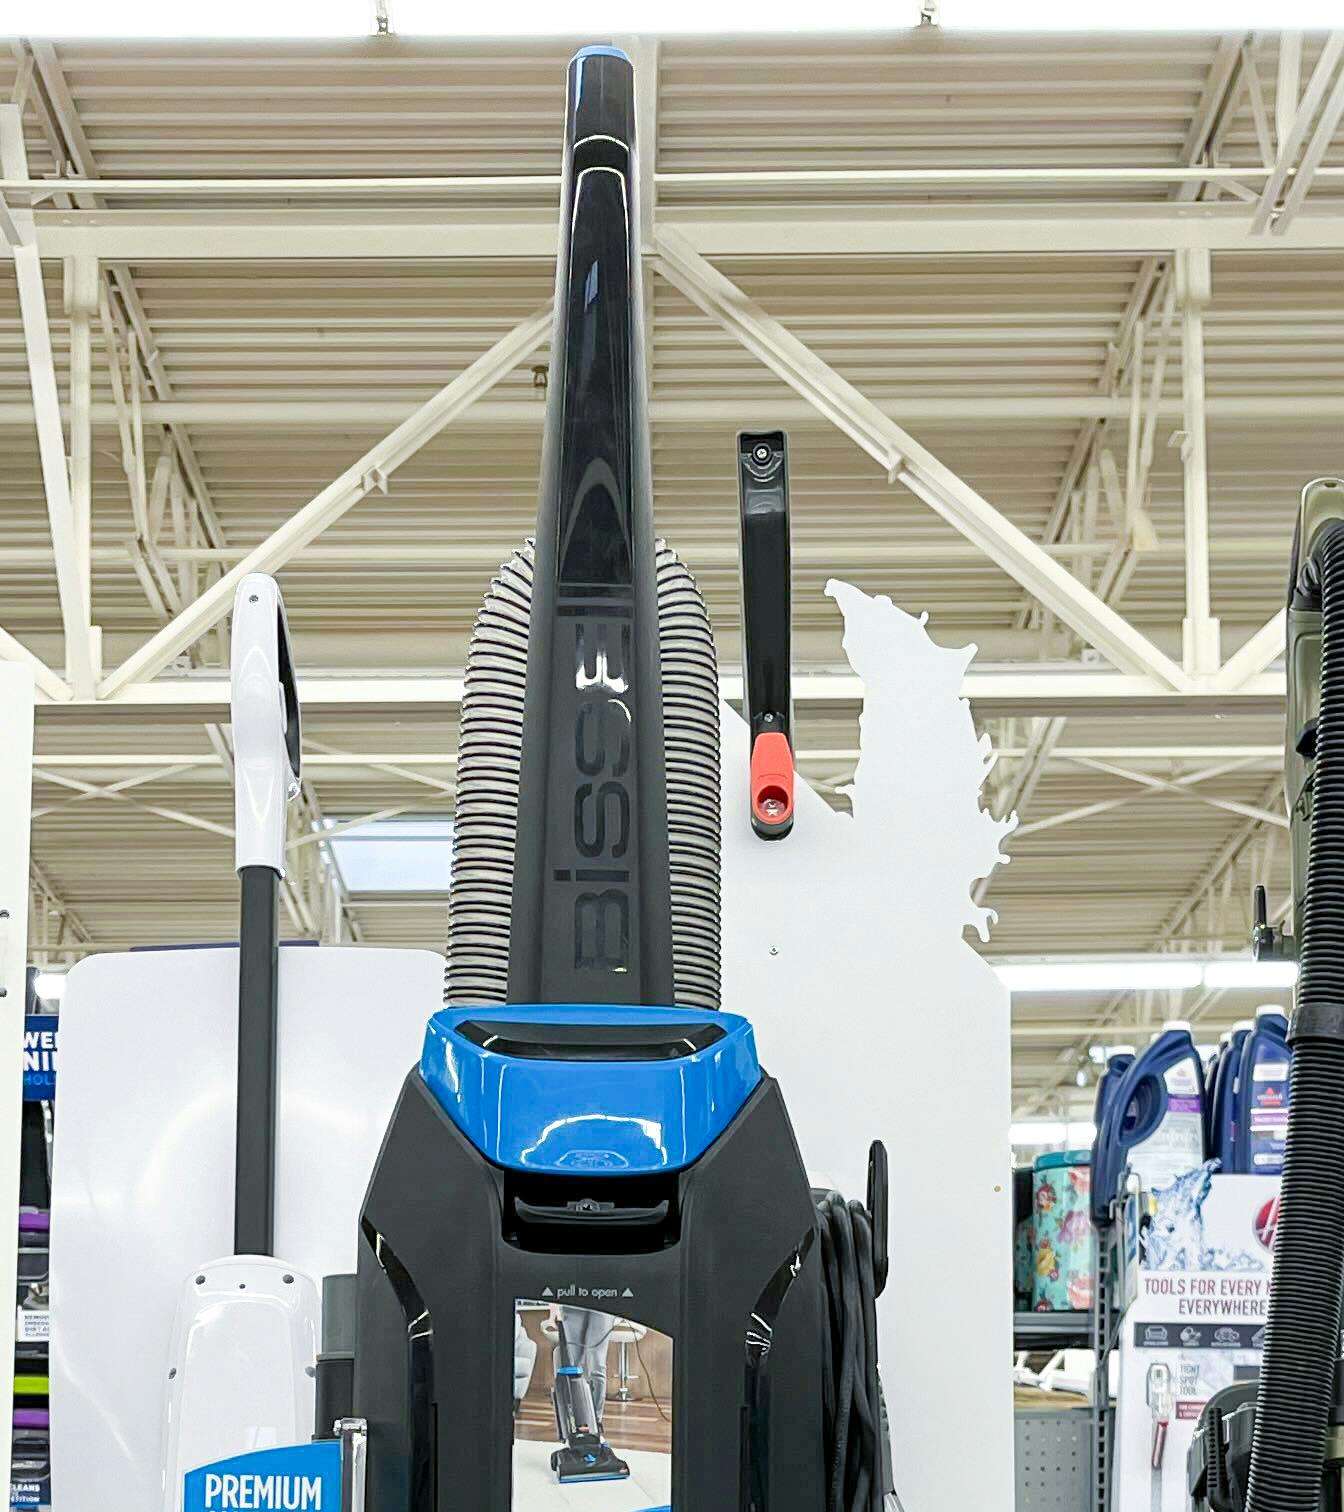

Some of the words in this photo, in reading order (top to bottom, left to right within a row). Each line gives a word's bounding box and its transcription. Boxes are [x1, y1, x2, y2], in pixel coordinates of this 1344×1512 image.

[557, 1285, 576, 1298] pull
[579, 1286, 589, 1297] to
[591, 1287, 618, 1300] open
[1144, 1279, 1186, 1295] TOOLS
[1190, 1279, 1216, 1295] FOR
[1220, 1279, 1263, 1296] EVERY
[1178, 1298, 1267, 1316] EVERYWHERE
[205, 1473, 323, 1512] PREMIUM
